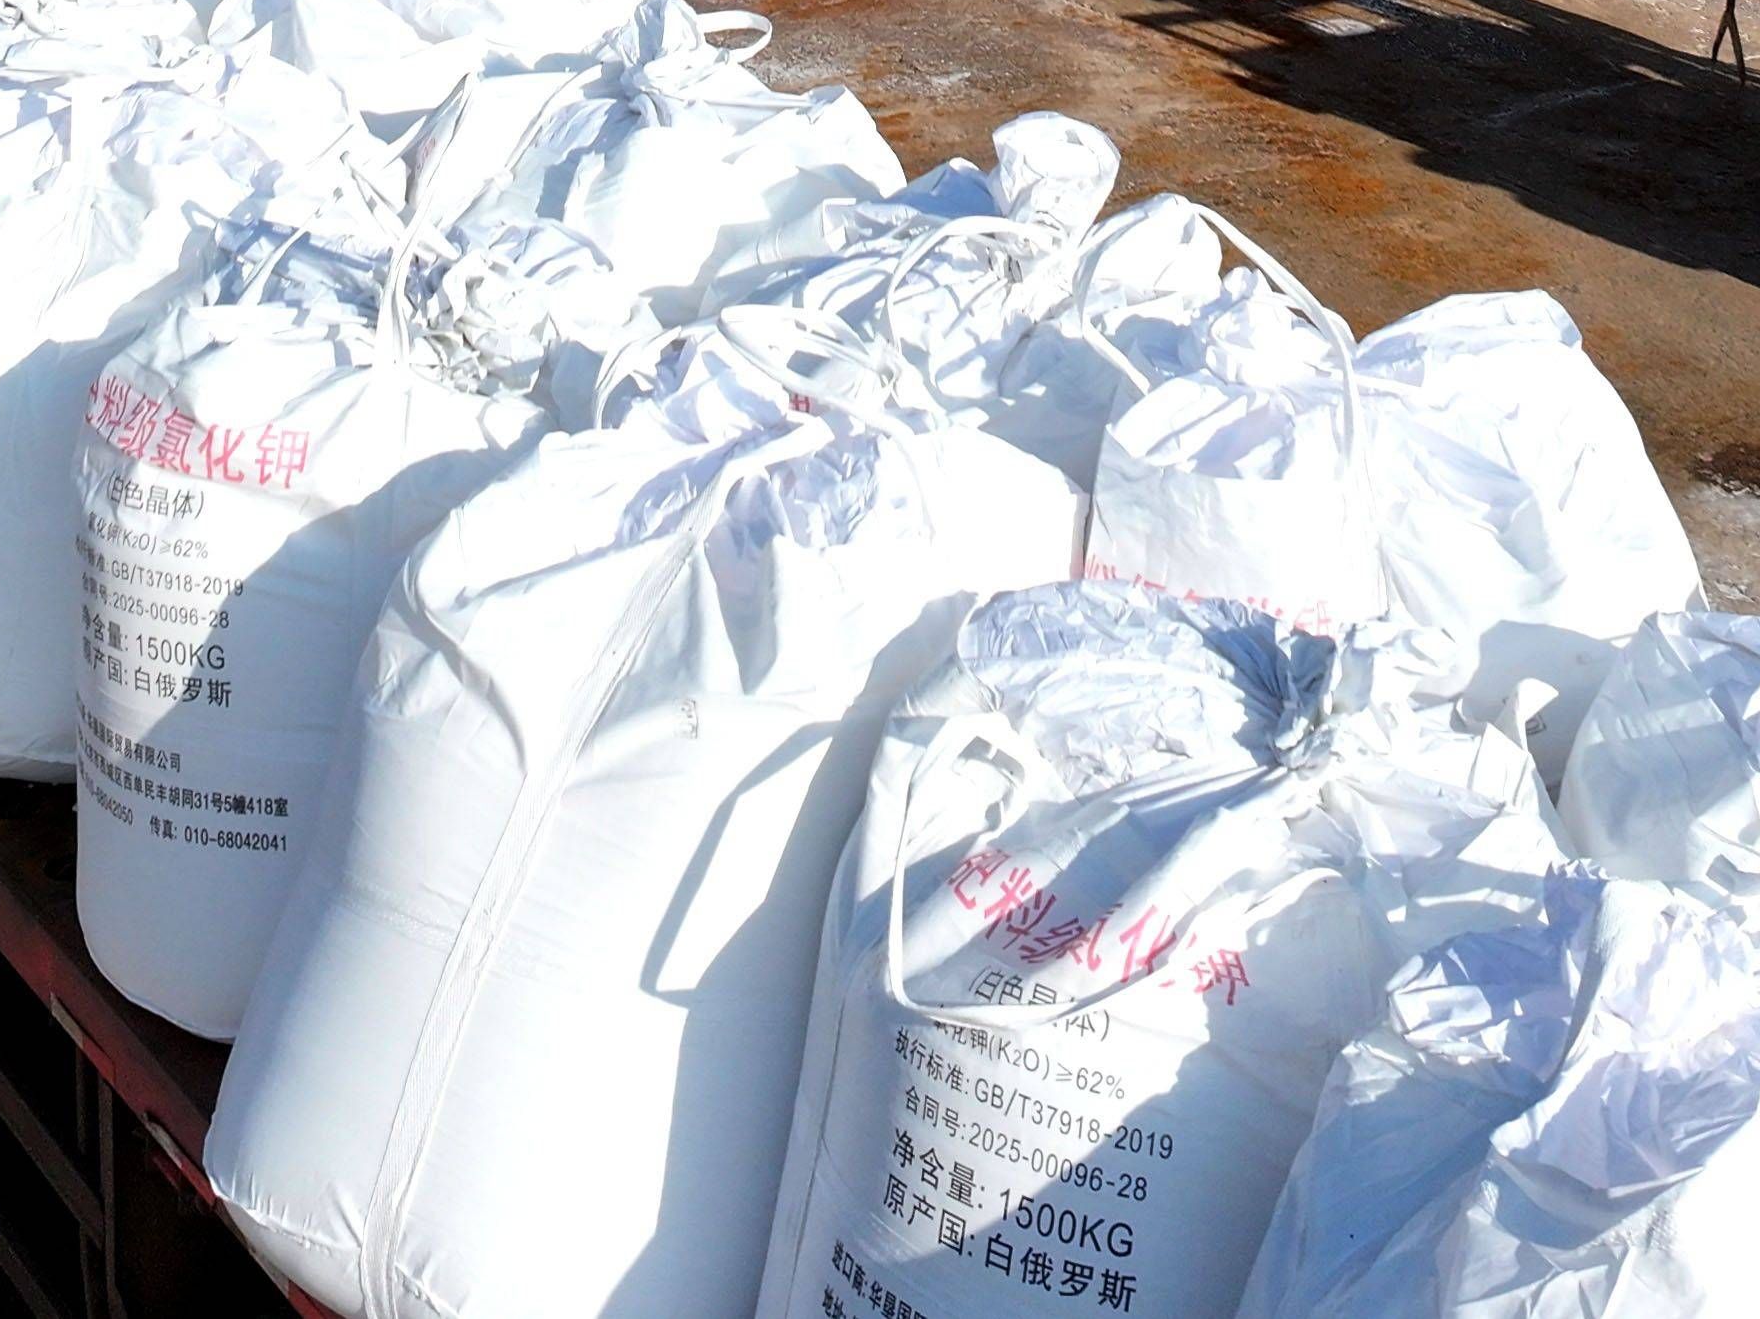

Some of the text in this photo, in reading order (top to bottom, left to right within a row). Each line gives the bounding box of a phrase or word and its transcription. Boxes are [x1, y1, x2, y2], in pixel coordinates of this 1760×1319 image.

[106, 469, 206, 520] (白色晶体)
[136, 633, 226, 671] 1500KG
[134, 666, 233, 709] 白俄罗斯
[184, 825, 288, 852] 010-68042041
[891, 1127, 1135, 1258] 净含量: 1500KG
[883, 1173, 1138, 1313] 原产国: 白俄罗斯
